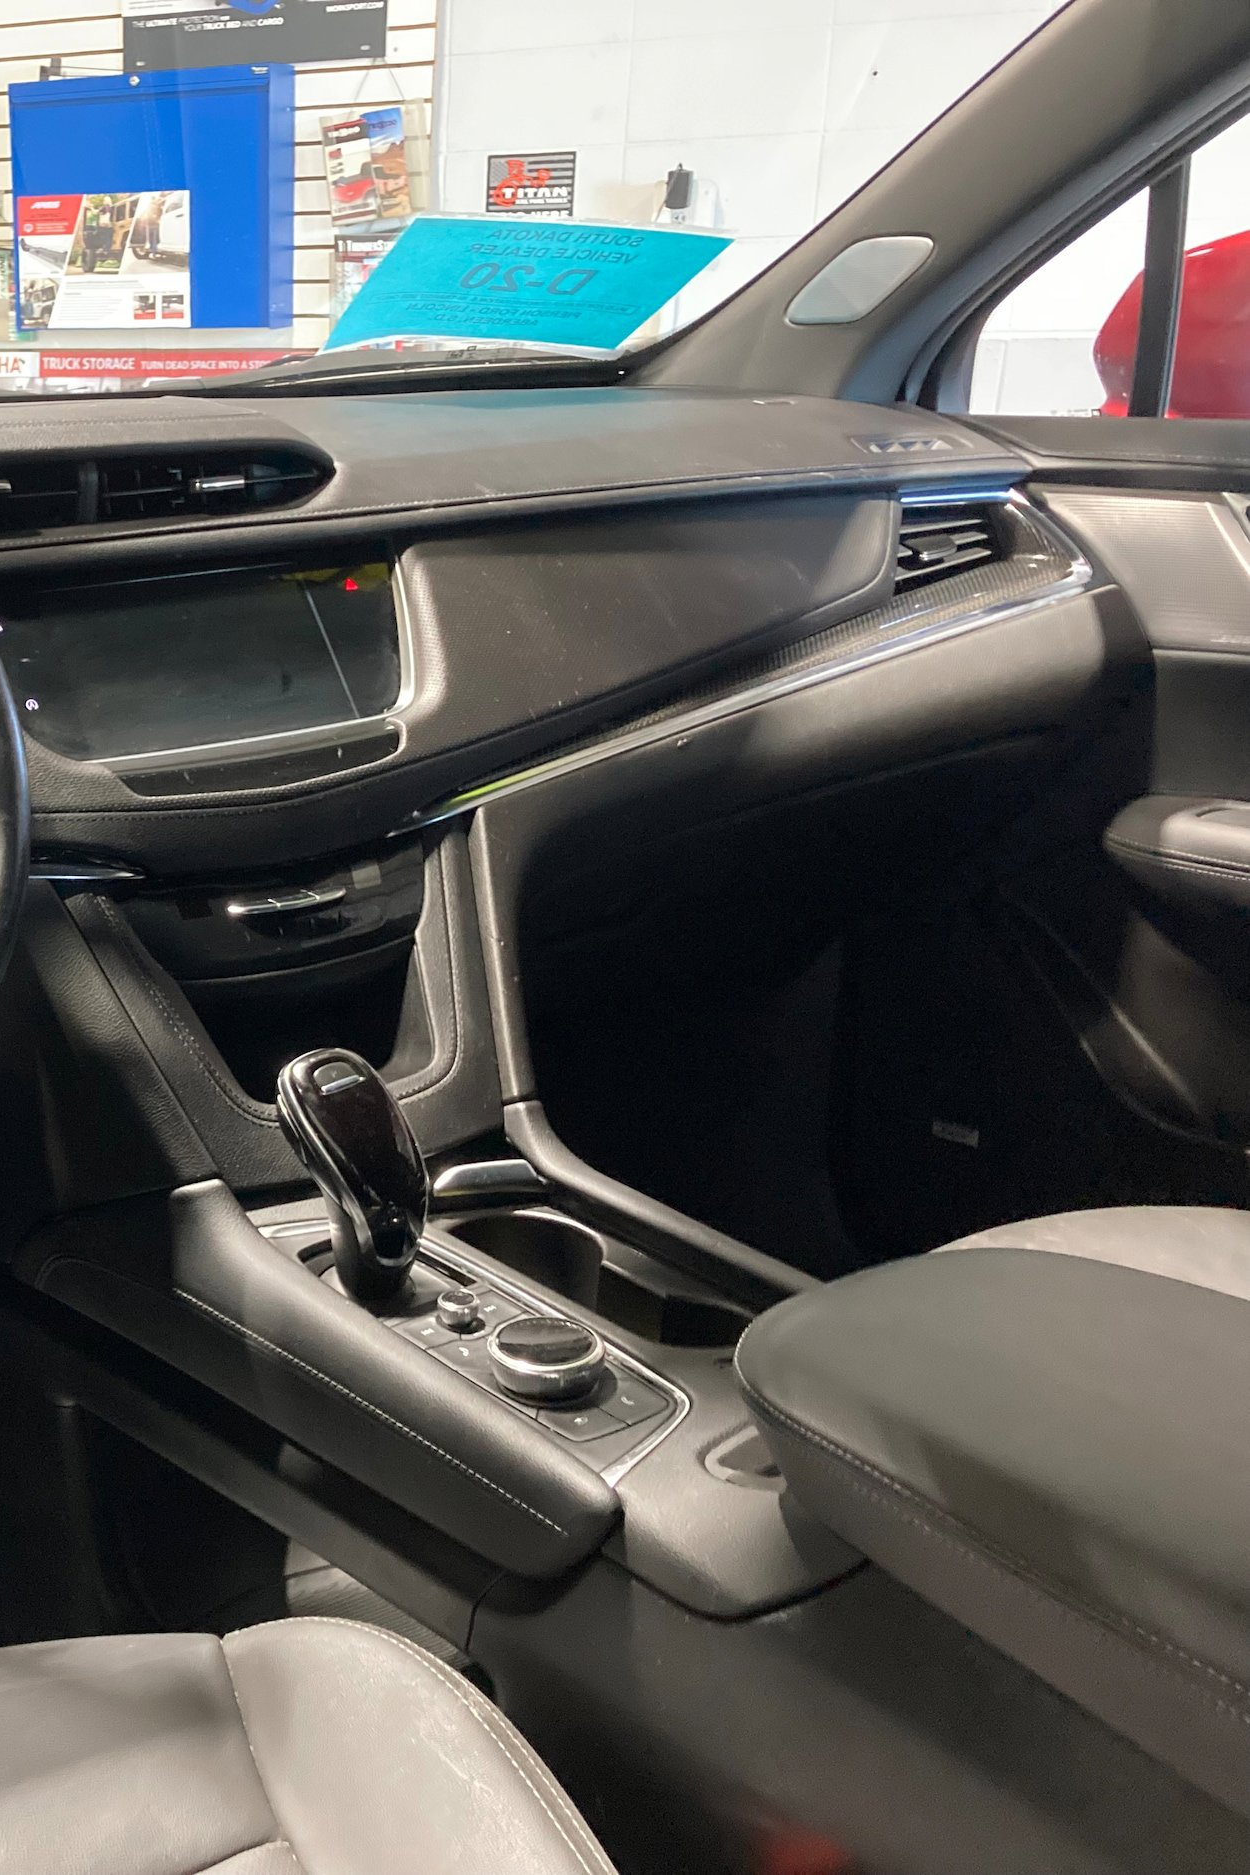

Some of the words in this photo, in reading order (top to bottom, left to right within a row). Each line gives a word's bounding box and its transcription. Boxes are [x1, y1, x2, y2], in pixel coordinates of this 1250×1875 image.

[145, 17, 178, 28] ULTIMATE
[184, 23, 203, 32] YOUR
[203, 20, 226, 31] TRUCK
[226, 20, 241, 29] BED
[242, 19, 257, 28] AND
[257, 17, 284, 27] CARGO
[502, 186, 568, 199] TITAN
[43, 356, 80, 371] TRUCK
[82, 356, 136, 371] STORAGE
[140, 359, 165, 370] TURN
[165, 359, 188, 370] DEAD
[189, 360, 217, 370] SPACE
[218, 360, 240, 370] INTO
[240, 360, 248, 369] A
